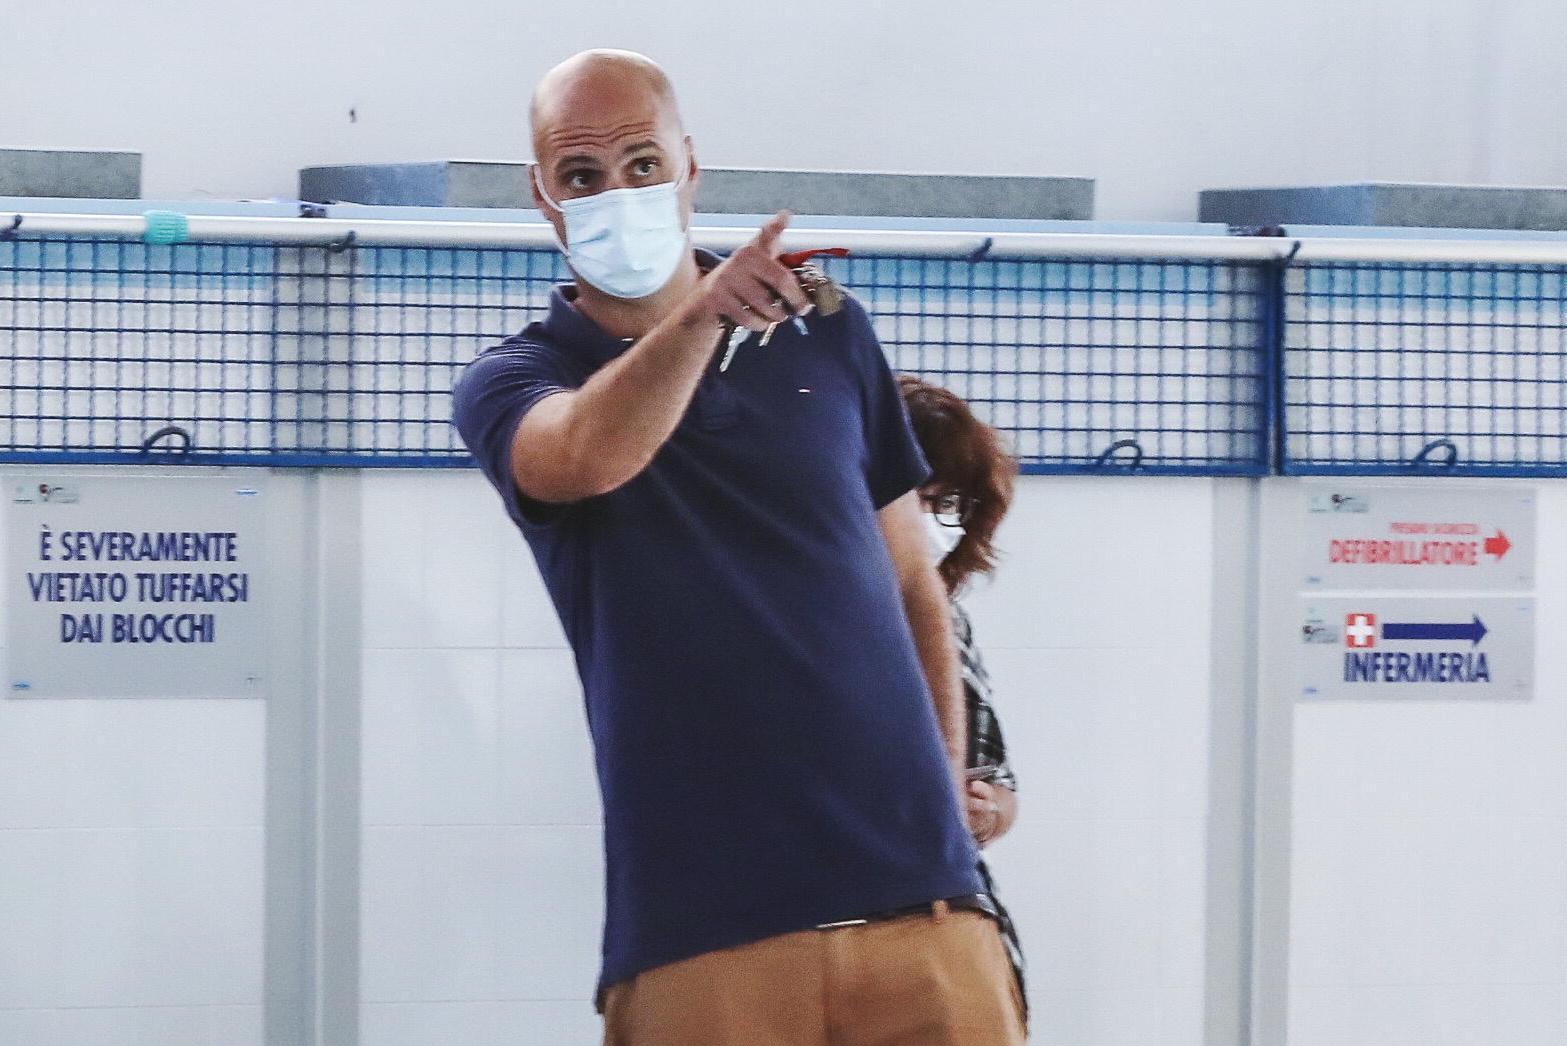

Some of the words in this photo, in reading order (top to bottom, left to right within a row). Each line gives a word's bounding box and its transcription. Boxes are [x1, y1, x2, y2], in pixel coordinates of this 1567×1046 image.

[39, 523, 53, 560] È
[59, 531, 237, 562] SEVERAMENTE
[1328, 539, 1478, 565] DEFIBRILLATORE
[27, 572, 128, 602] VIETATO
[135, 572, 249, 602] TUFFARSI
[60, 613, 104, 644] DAI
[111, 613, 215, 644] BLOCCHI
[1343, 651, 1491, 683] INFERMERIA
